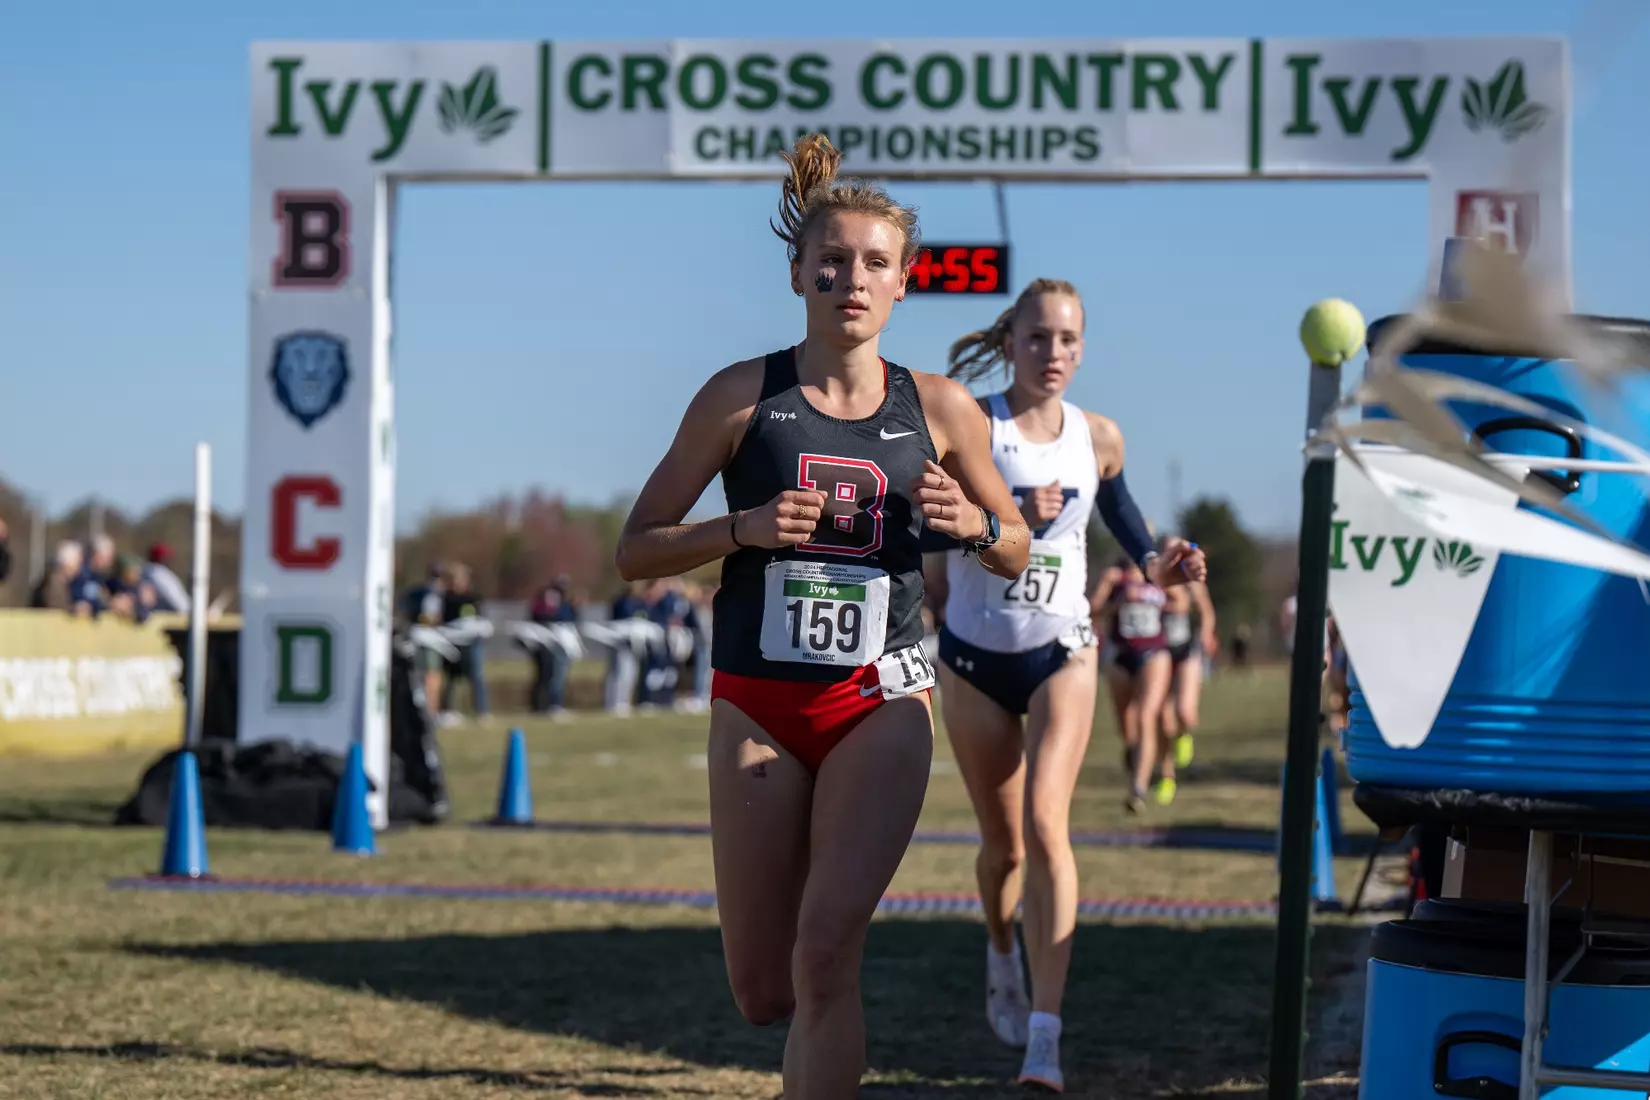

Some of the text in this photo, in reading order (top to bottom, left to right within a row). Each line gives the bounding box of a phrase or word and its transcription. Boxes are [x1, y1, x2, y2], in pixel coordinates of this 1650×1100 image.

[265, 57, 425, 161] Ivy
[565, 52, 1236, 111] CROSS COUNTRY
[1283, 54, 1450, 161] Ivy
[273, 189, 351, 289] B
[770, 410, 787, 422] Ivy
[270, 474, 343, 572] C
[795, 453, 888, 557] B
[809, 583, 828, 597] Ivy
[1328, 520, 1427, 588] Ivy
[276, 624, 334, 704] D
[786, 599, 862, 653] 159
